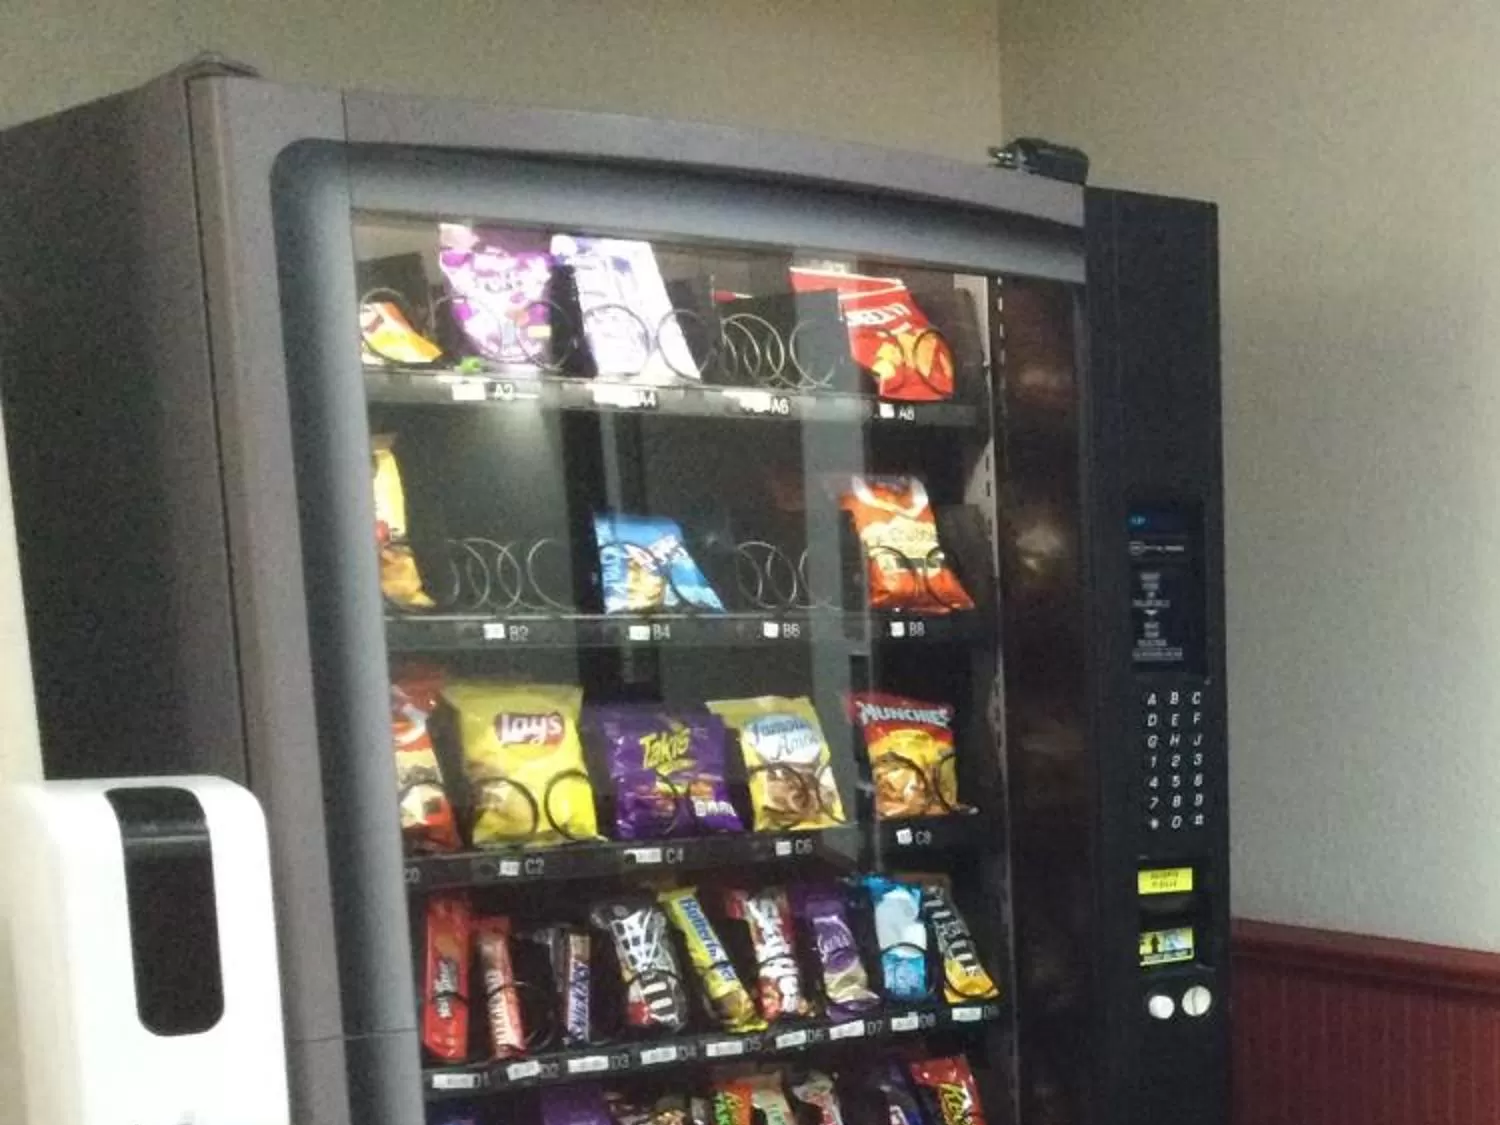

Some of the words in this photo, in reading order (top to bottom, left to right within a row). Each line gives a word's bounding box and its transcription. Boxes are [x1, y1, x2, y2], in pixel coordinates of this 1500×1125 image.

[508, 624, 529, 641] B2
[653, 623, 670, 639] B4
[1147, 692, 1157, 705] A
[1170, 690, 1179, 705] B
[1192, 691, 1201, 705] C
[856, 700, 953, 729] MUNCHIES
[1148, 712, 1158, 727] D
[1171, 712, 1180, 727] E
[1193, 712, 1201, 725] F
[1170, 733, 1180, 746] H
[1193, 733, 1203, 746] J
[639, 730, 690, 770] Takis
[1151, 755, 1157, 768] 1
[1171, 753, 1181, 767] 2
[1194, 753, 1203, 766] 3
[1149, 776, 1158, 789] 4
[1172, 775, 1180, 788] 5
[1149, 796, 1159, 810] 7
[1172, 795, 1181, 808] 8
[795, 839, 813, 855] C6
[524, 859, 544, 876] C2
[867, 1020, 884, 1035] D7
